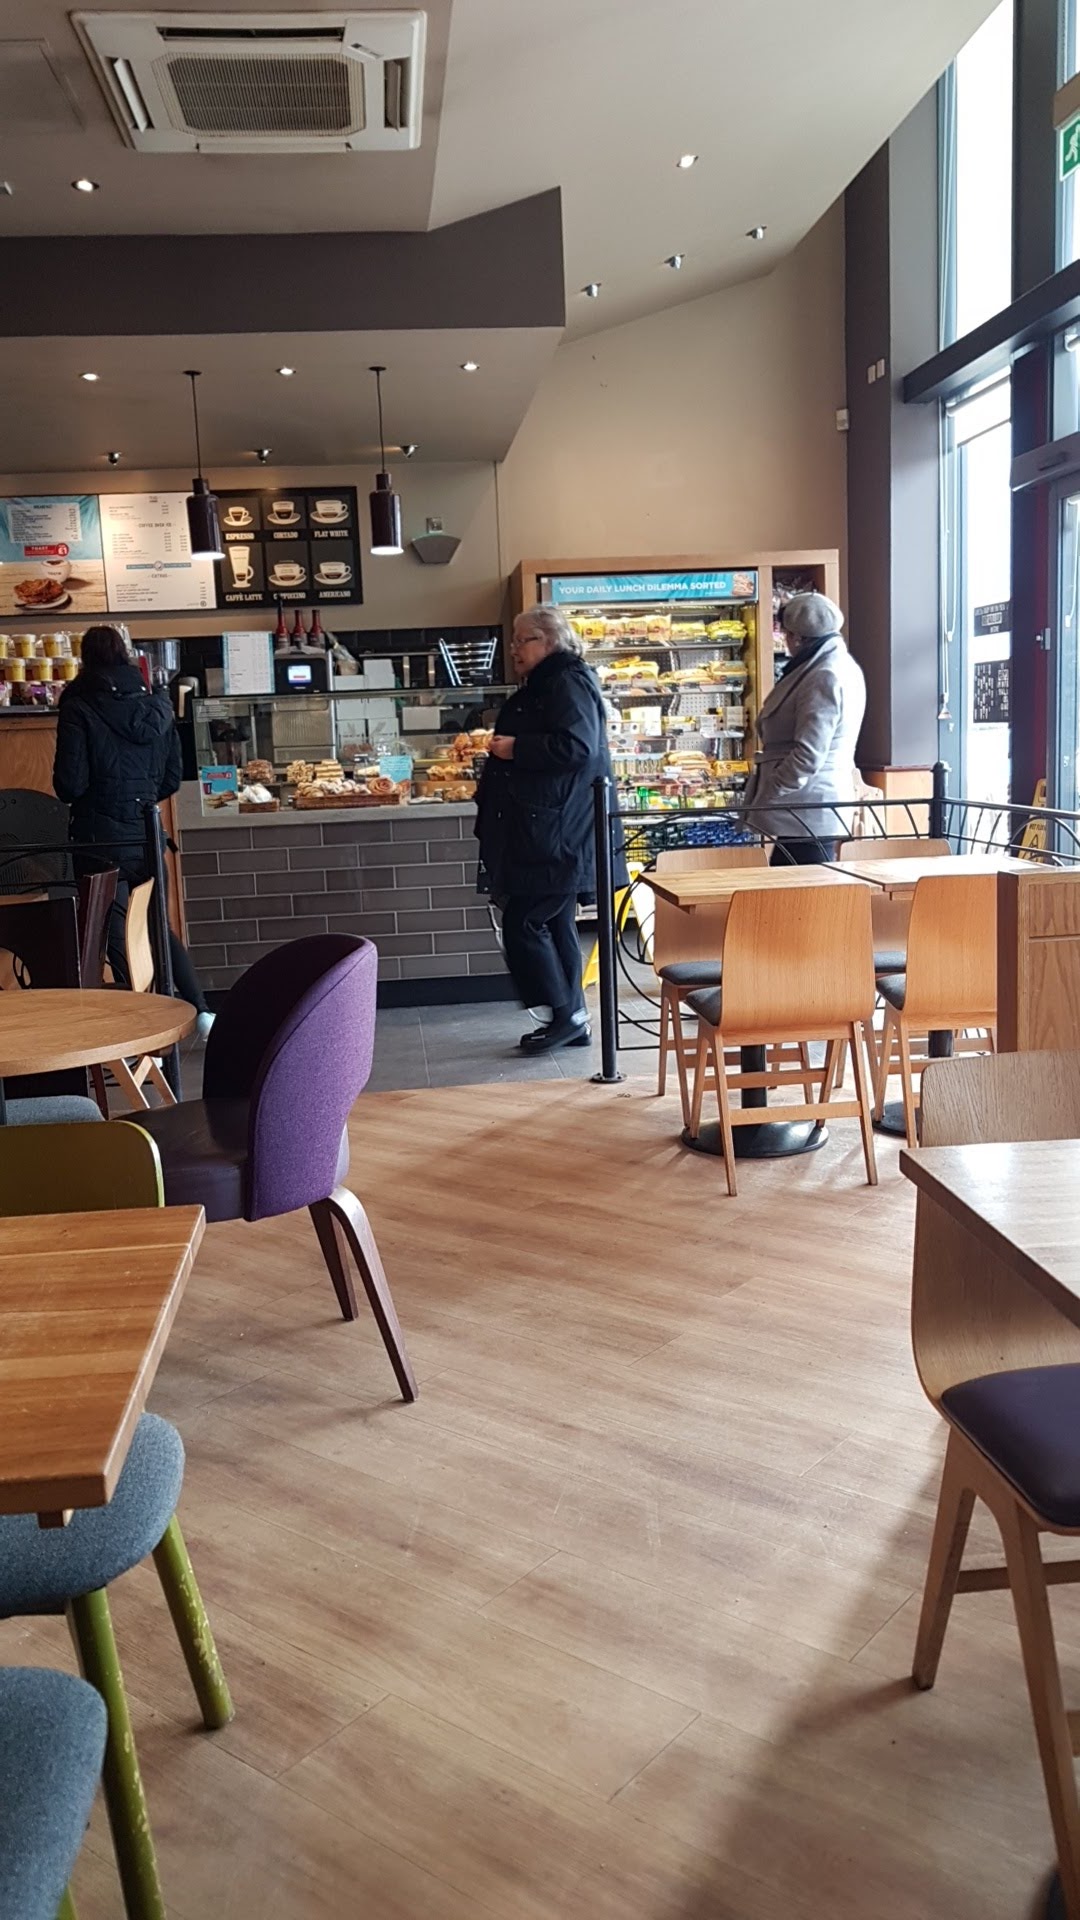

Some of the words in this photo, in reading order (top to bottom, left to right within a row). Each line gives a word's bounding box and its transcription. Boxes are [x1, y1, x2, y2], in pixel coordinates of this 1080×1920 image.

[225, 532, 255, 540] ESPRESSO
[314, 530, 328, 538] FLAT
[329, 529, 349, 537] WHITE
[559, 585, 585, 594] YOUR
[586, 584, 613, 594] DAILY
[614, 583, 645, 593] LUNCH
[690, 581, 726, 591] SORTED
[244, 593, 263, 601] LATTE
[318, 590, 351, 599] AMERICANO
